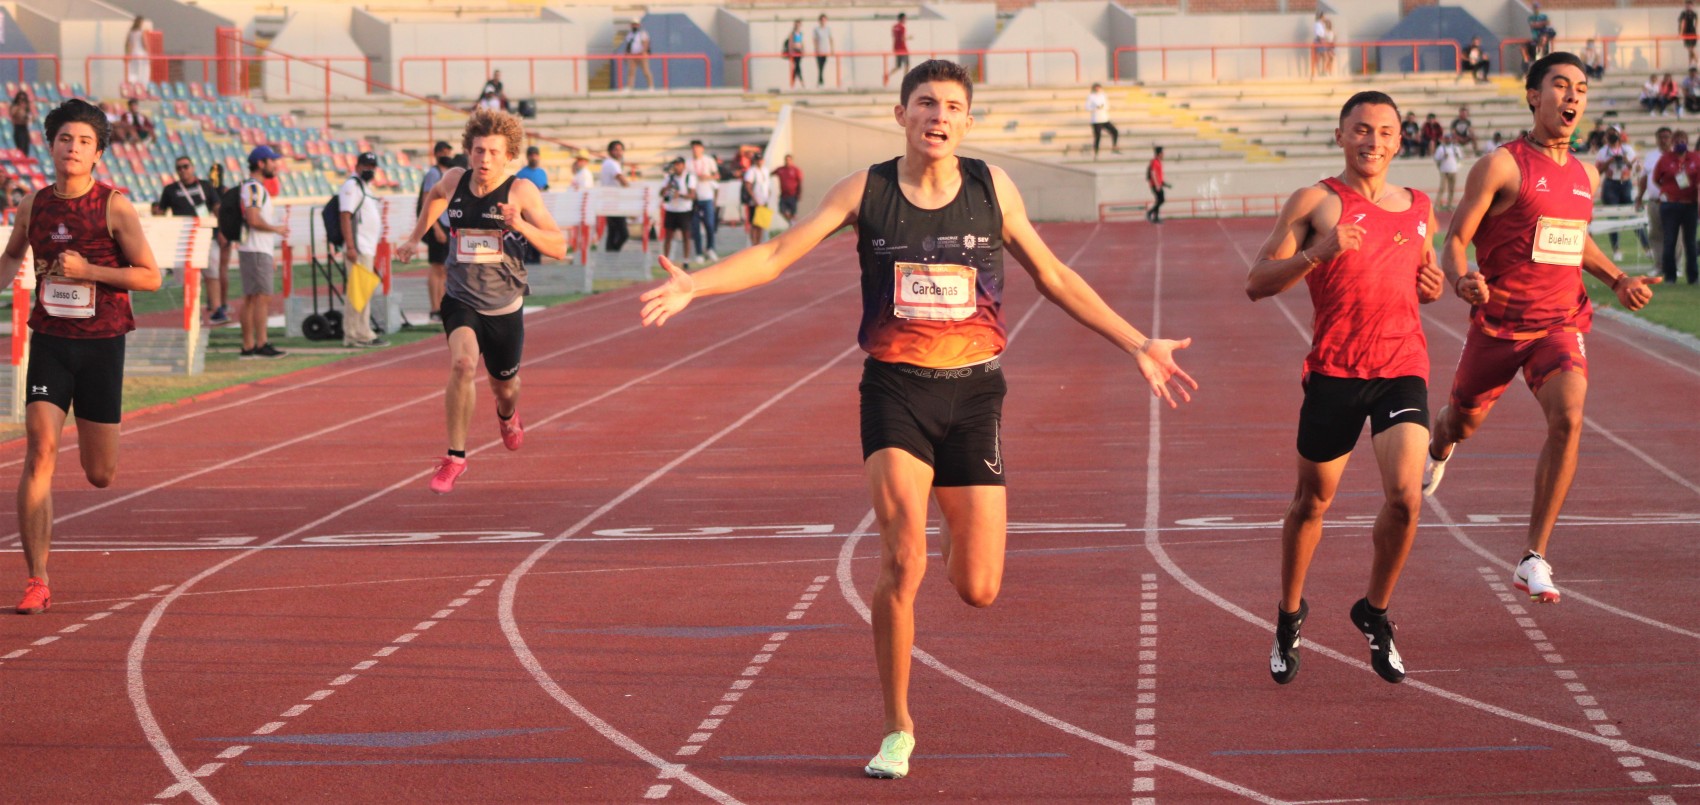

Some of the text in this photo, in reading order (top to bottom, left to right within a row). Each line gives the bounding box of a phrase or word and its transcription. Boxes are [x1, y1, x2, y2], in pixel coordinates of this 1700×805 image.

[1548, 233, 1572, 245] Buelna
[52, 288, 81, 301] Jasso G.
[911, 281, 958, 296] Cardenas
[933, 367, 973, 379] PRO
[591, 523, 837, 538] 5
